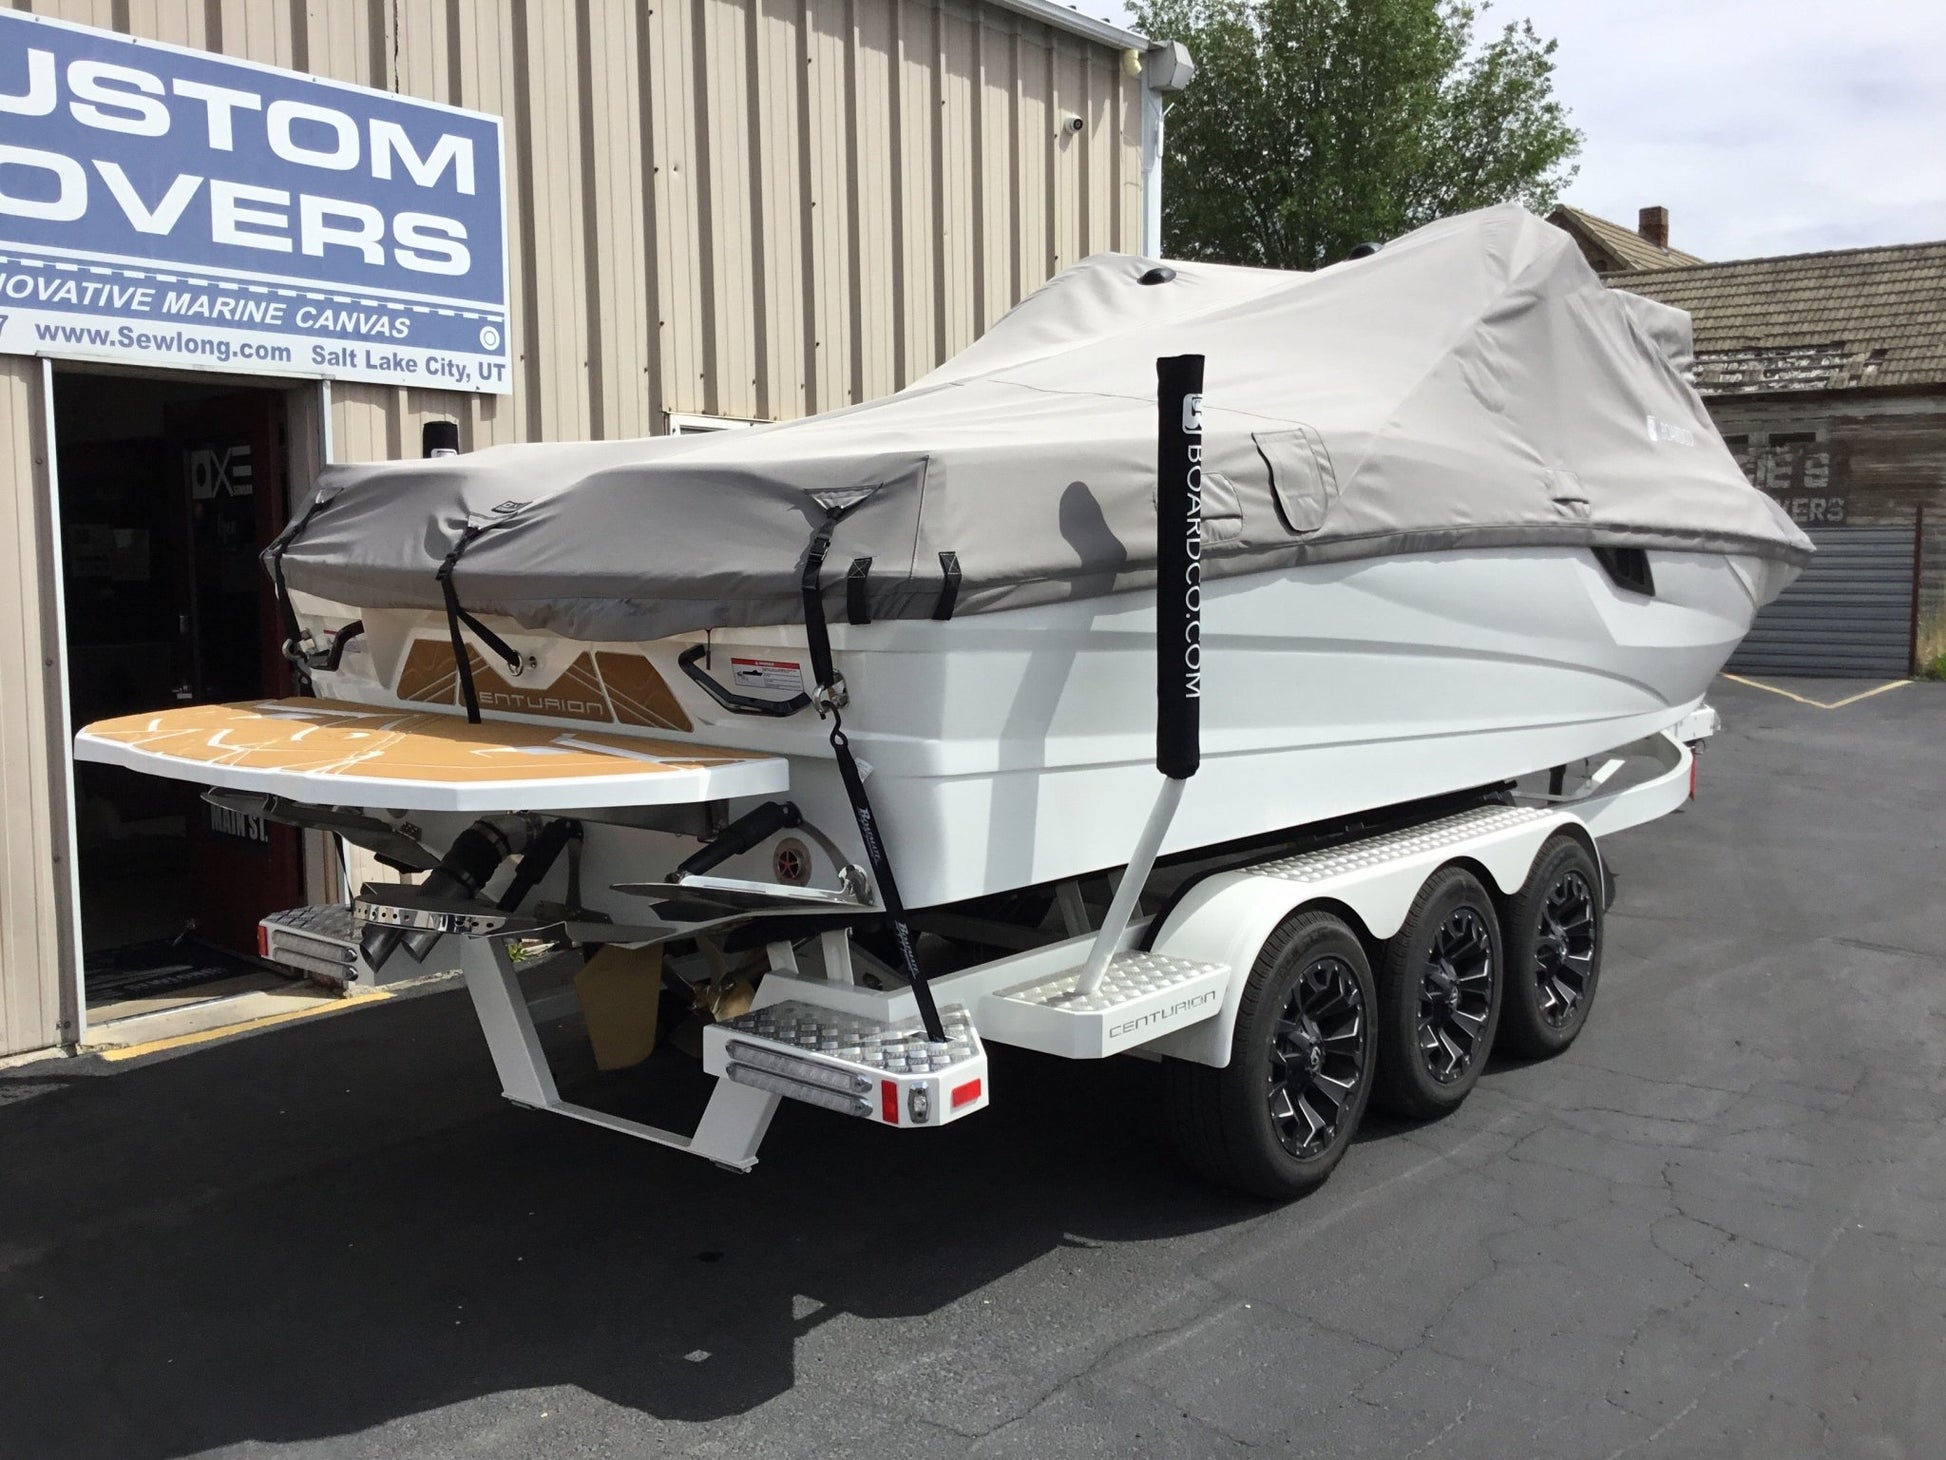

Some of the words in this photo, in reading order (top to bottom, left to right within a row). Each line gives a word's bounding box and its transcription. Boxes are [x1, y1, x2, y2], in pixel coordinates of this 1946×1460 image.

[162, 291, 287, 326] MARINE
[295, 306, 411, 339] CANVAS
[35, 323, 292, 363] www.Sewlong.com
[311, 344, 358, 368] Salt
[365, 350, 418, 373] Lake
[425, 356, 471, 383] City,
[478, 362, 506, 382] UT
[1185, 444, 1202, 698] BOARDCO.COM
[478, 691, 604, 715] ENTURION
[1109, 990, 1216, 1039] CENTURION
